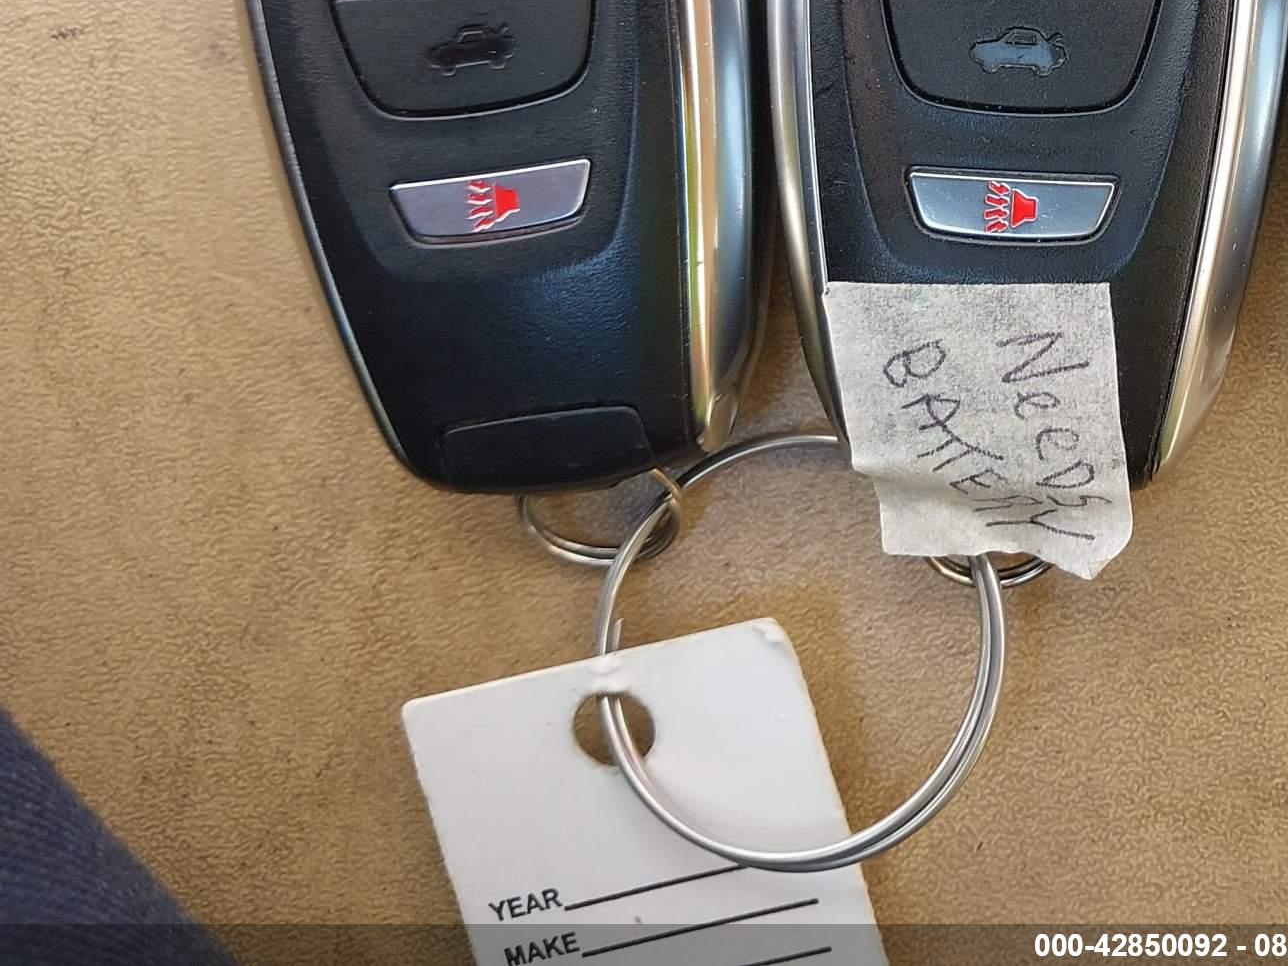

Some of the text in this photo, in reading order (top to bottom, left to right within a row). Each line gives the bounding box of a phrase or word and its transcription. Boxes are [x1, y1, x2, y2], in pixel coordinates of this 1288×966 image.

[882, 338, 1097, 541] BATTERY
[488, 888, 563, 921] YEAR
[504, 931, 581, 966] MAKE
